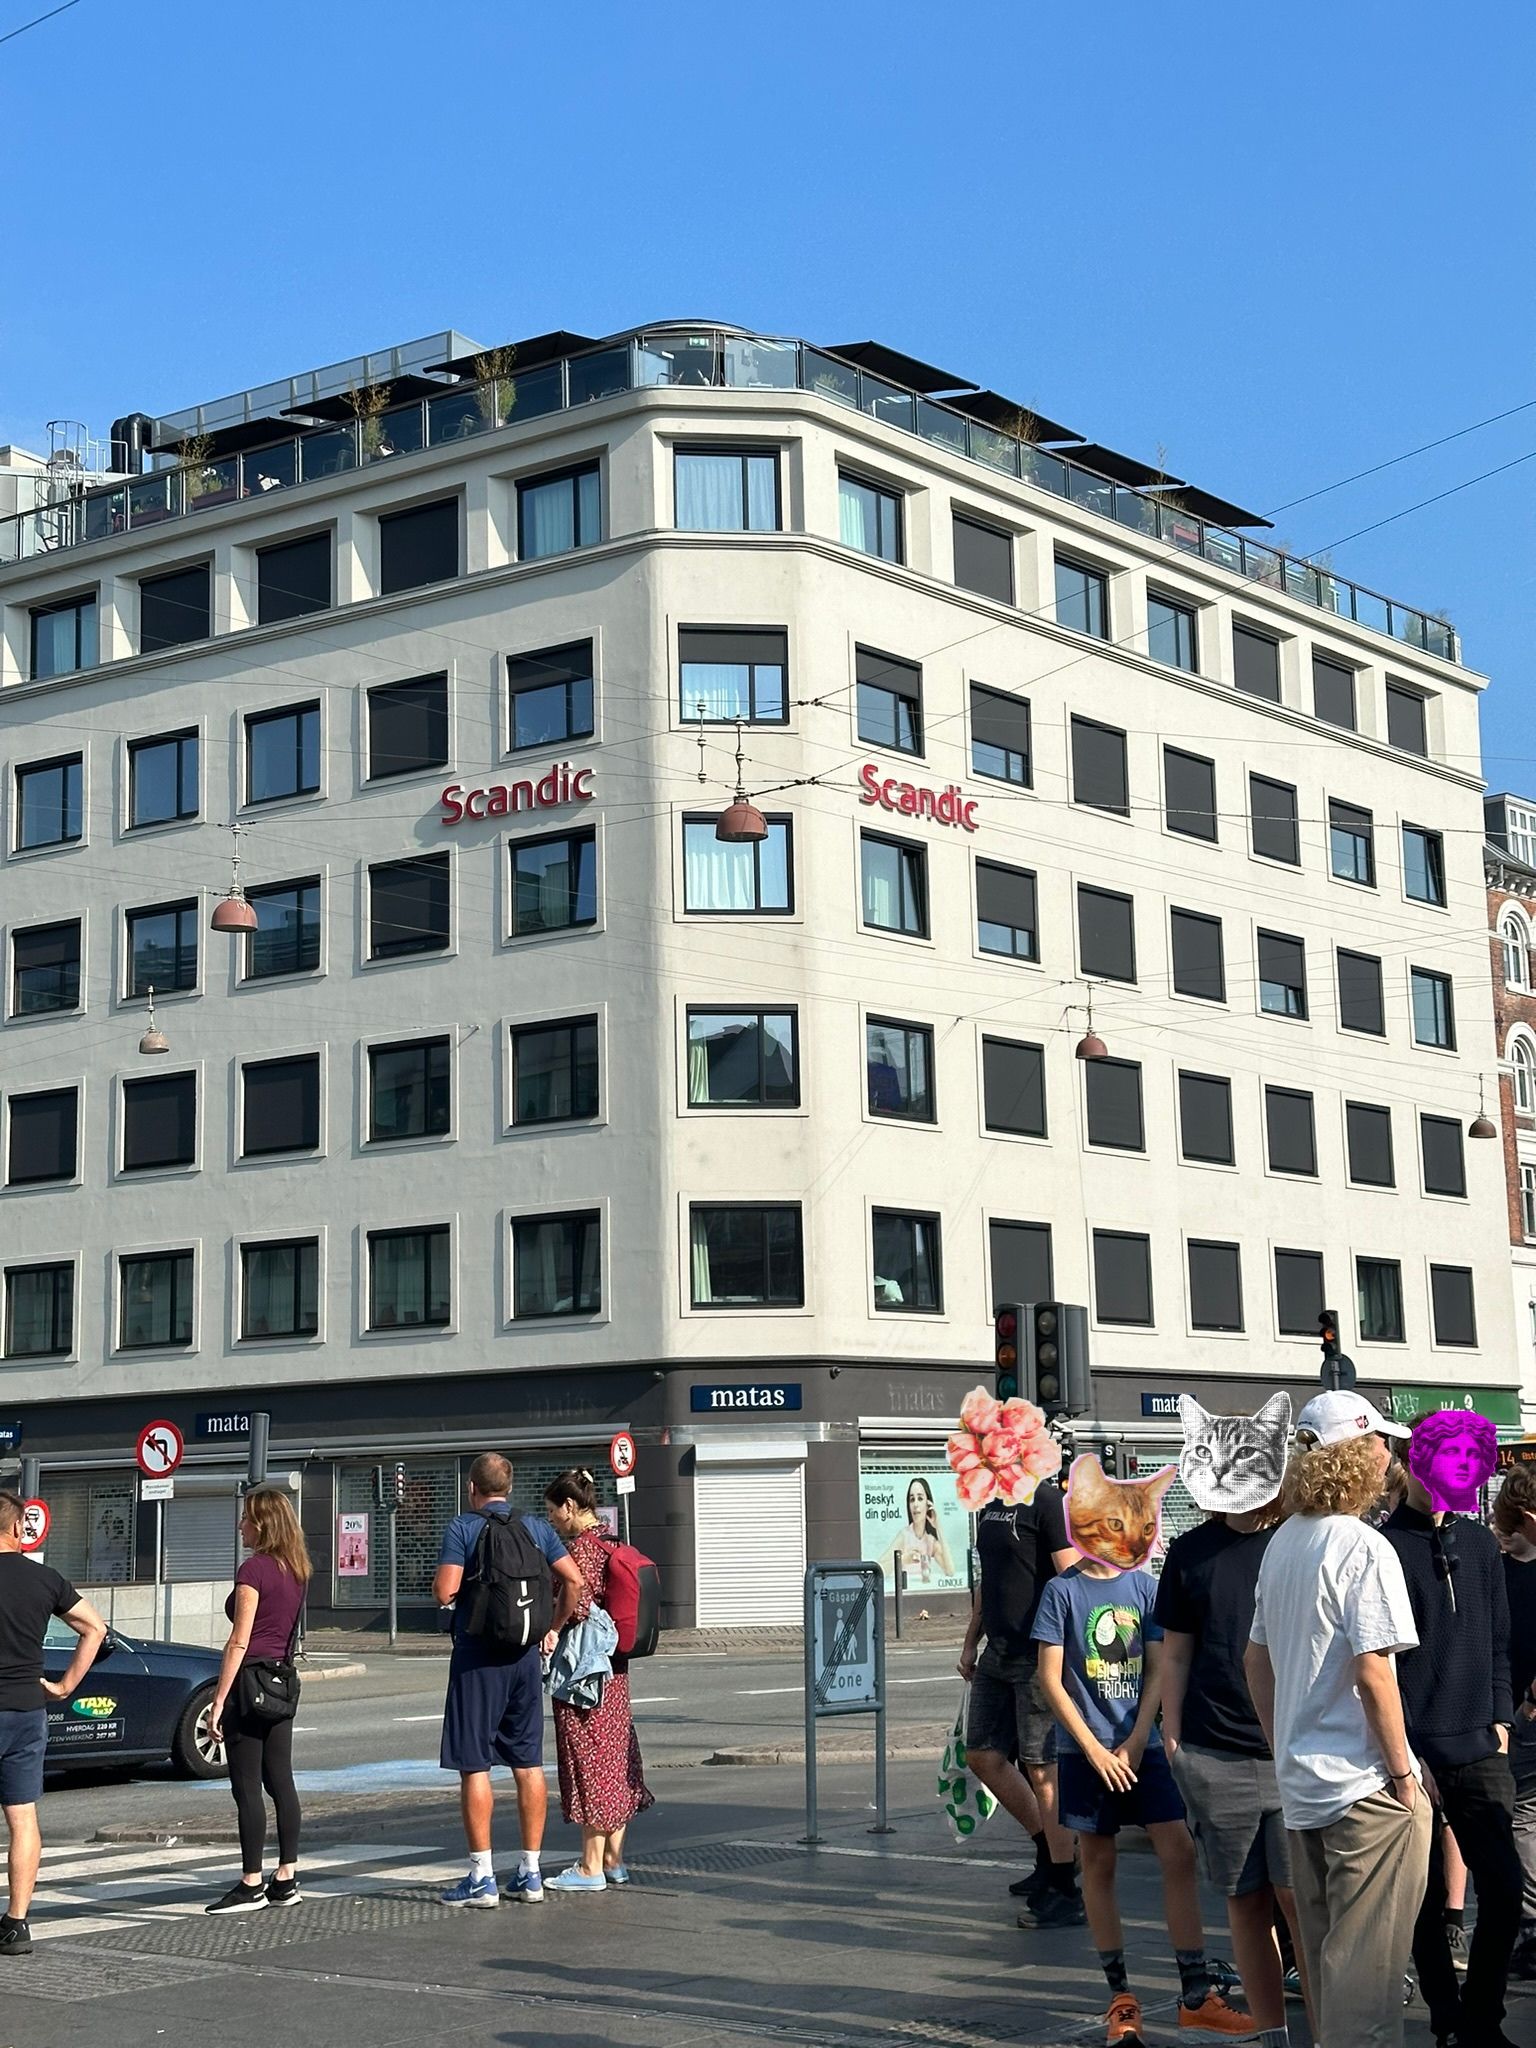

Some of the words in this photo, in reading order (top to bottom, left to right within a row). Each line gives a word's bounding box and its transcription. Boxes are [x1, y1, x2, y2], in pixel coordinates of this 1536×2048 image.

[441, 761, 597, 825] Scandic
[859, 763, 979, 832] Scandic
[711, 1386, 785, 1407] matas
[1152, 1396, 1181, 1412] mata
[207, 1413, 250, 1432] mata
[0, 1430, 14, 1439] atas
[1500, 1450, 1516, 1466] 14
[865, 1493, 895, 1506] Beskyt
[865, 1508, 879, 1519] din
[881, 1507, 902, 1522] glød.
[345, 1520, 363, 1530] 20%
[938, 1579, 963, 1588] CLINIQUE
[1097, 1680, 1139, 1700] FRIDAY!
